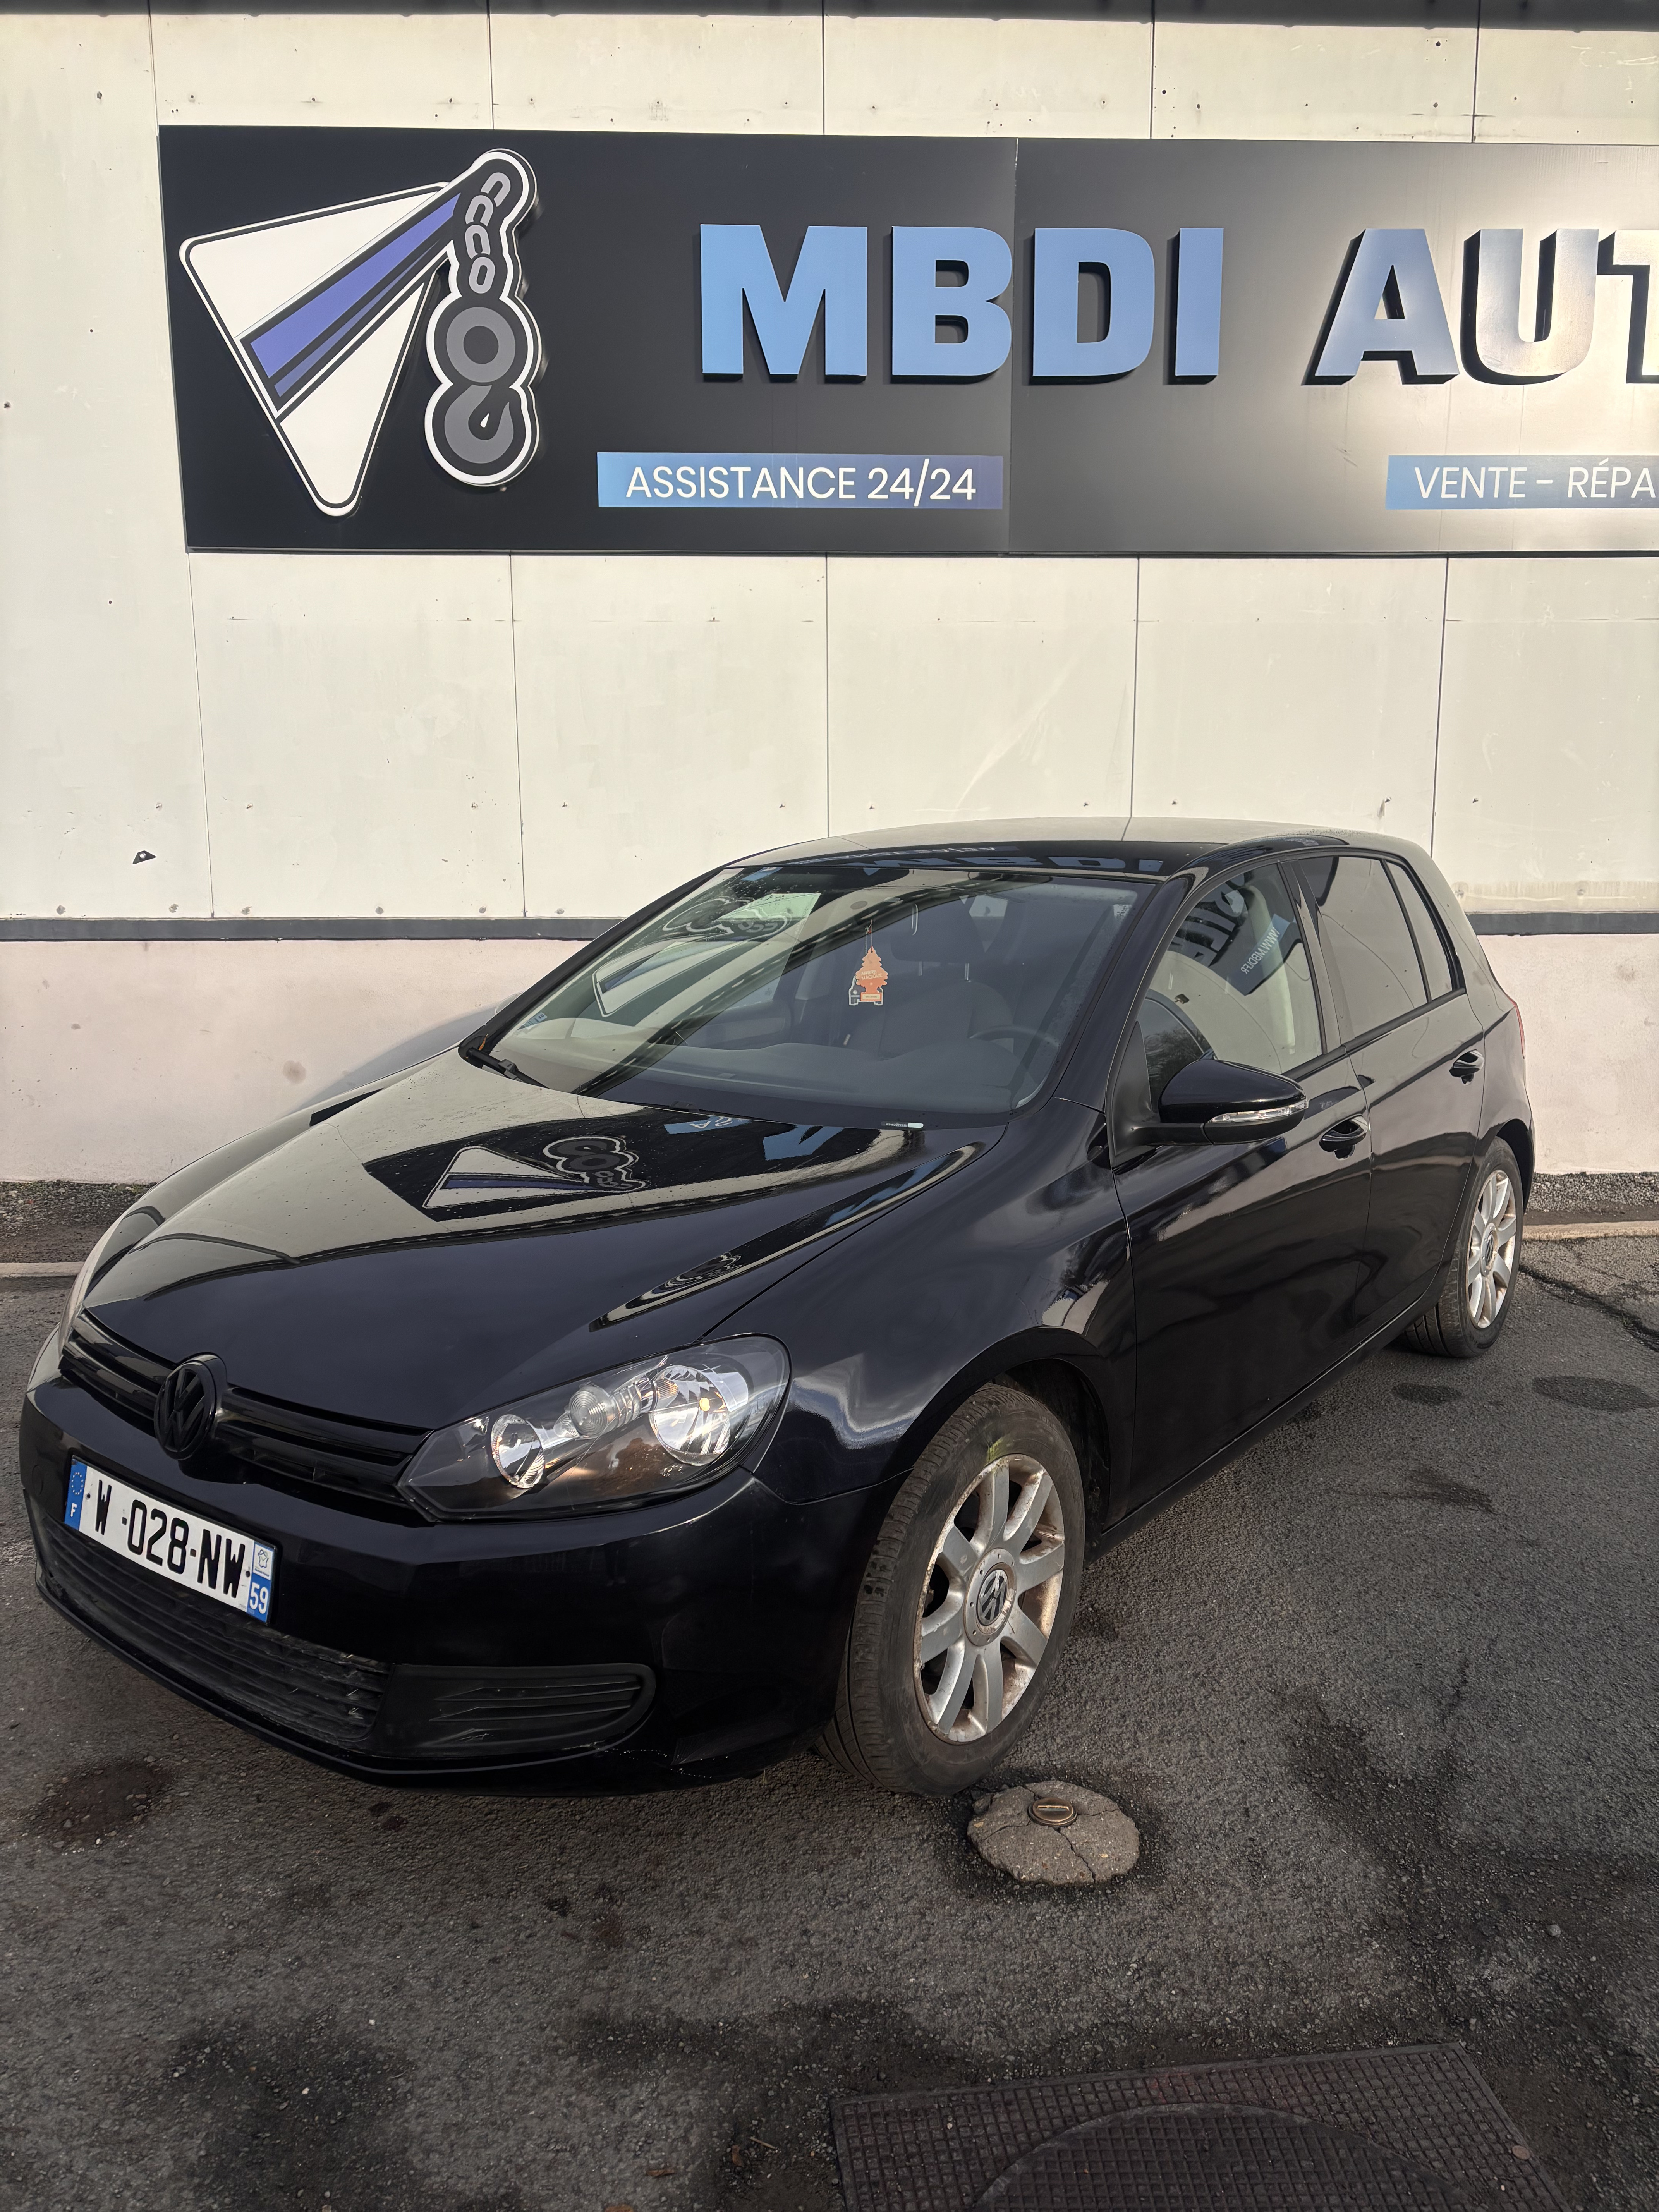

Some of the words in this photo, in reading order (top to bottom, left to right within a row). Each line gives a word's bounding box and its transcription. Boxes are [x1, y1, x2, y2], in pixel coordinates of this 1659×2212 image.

[700, 224, 1224, 378] MBDI
[625, 465, 856, 499] ASSISTANCE
[867, 458, 976, 507] 24/24
[1414, 467, 1527, 498] VENTE
[1567, 457, 1656, 498] RÉPA
[70, 1503, 77, 1517] F
[249, 1582, 269, 1614] 59
